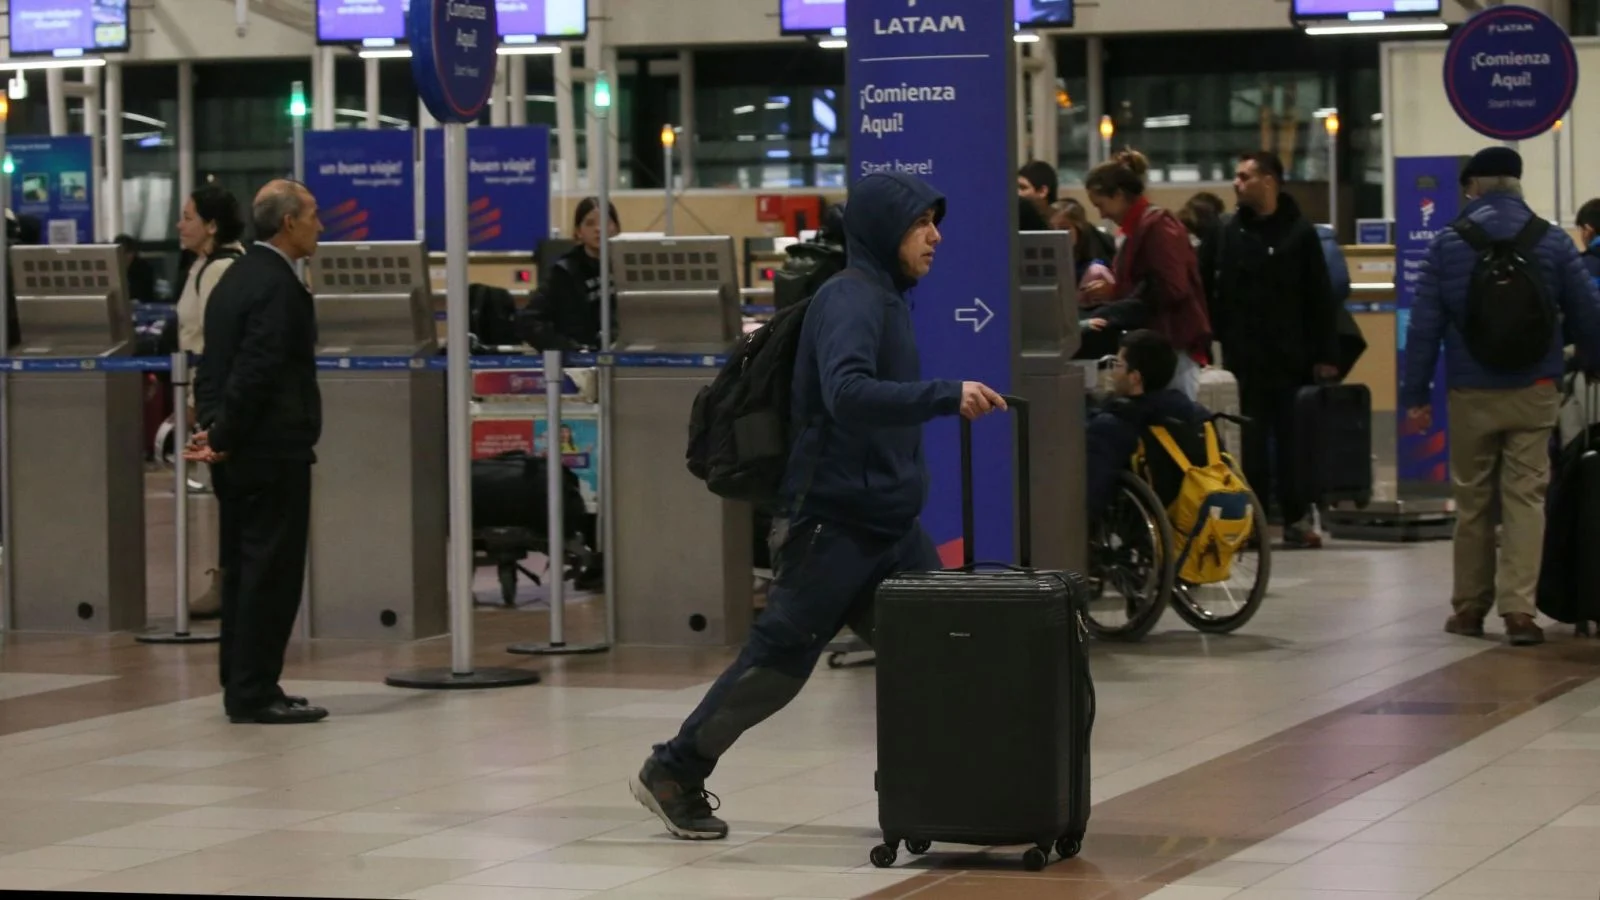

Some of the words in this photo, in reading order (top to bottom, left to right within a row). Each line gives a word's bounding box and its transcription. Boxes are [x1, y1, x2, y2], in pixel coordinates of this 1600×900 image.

[874, 16, 966, 35] LATAM
[1496, 23, 1534, 32] LATAM
[1471, 50, 1551, 71] ¡Comienza
[1491, 71, 1532, 91] Aquí!
[860, 82, 956, 110] ¡Comienza
[860, 113, 904, 139] Aquí!
[320, 163, 336, 175] un
[338, 160, 367, 175] buen
[470, 158, 499, 173] buen
[861, 160, 892, 177] Start
[895, 158, 933, 175] here!
